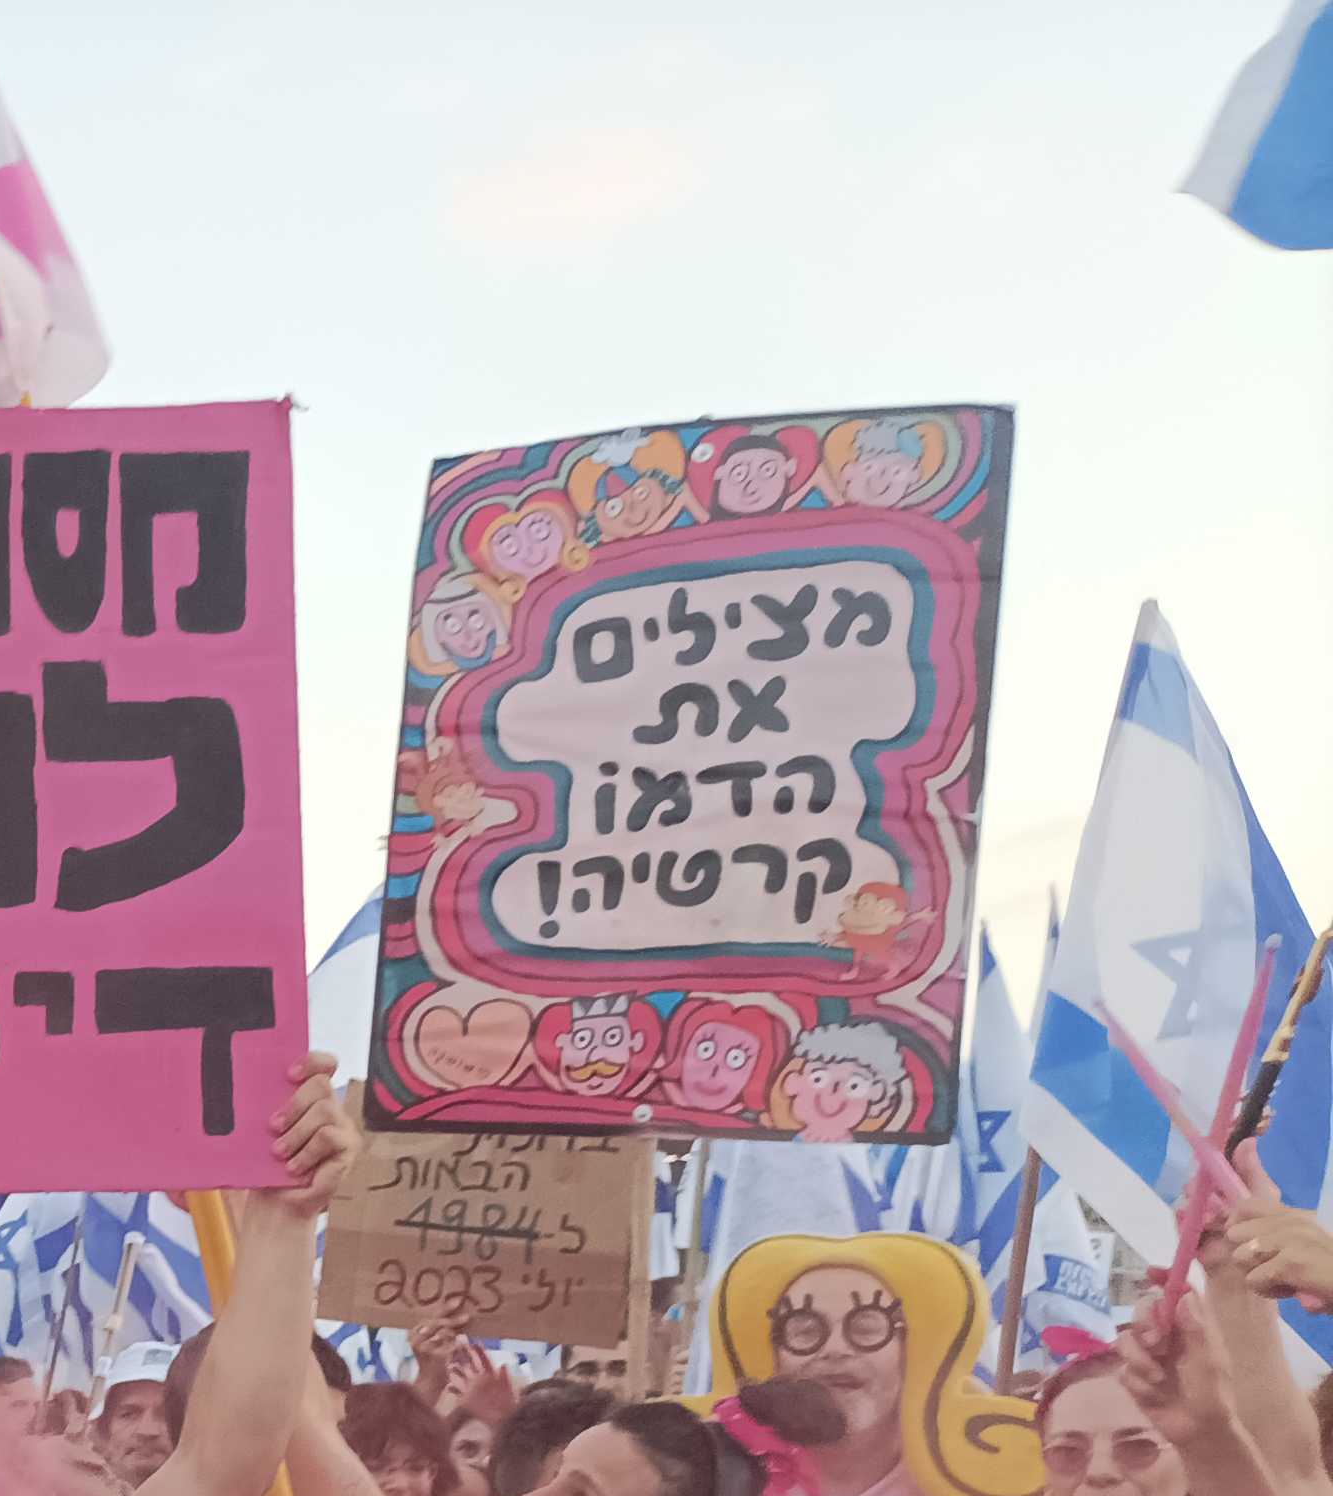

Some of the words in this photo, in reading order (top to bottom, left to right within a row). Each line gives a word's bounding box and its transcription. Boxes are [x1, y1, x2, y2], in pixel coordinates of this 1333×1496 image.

[573, 583, 892, 684] מצילים
[632, 675, 790, 744] את
[536, 837, 852, 939] קרטיה!
[367, 1156, 531, 1192] הבאות
[374, 1258, 503, 1318] 2023
